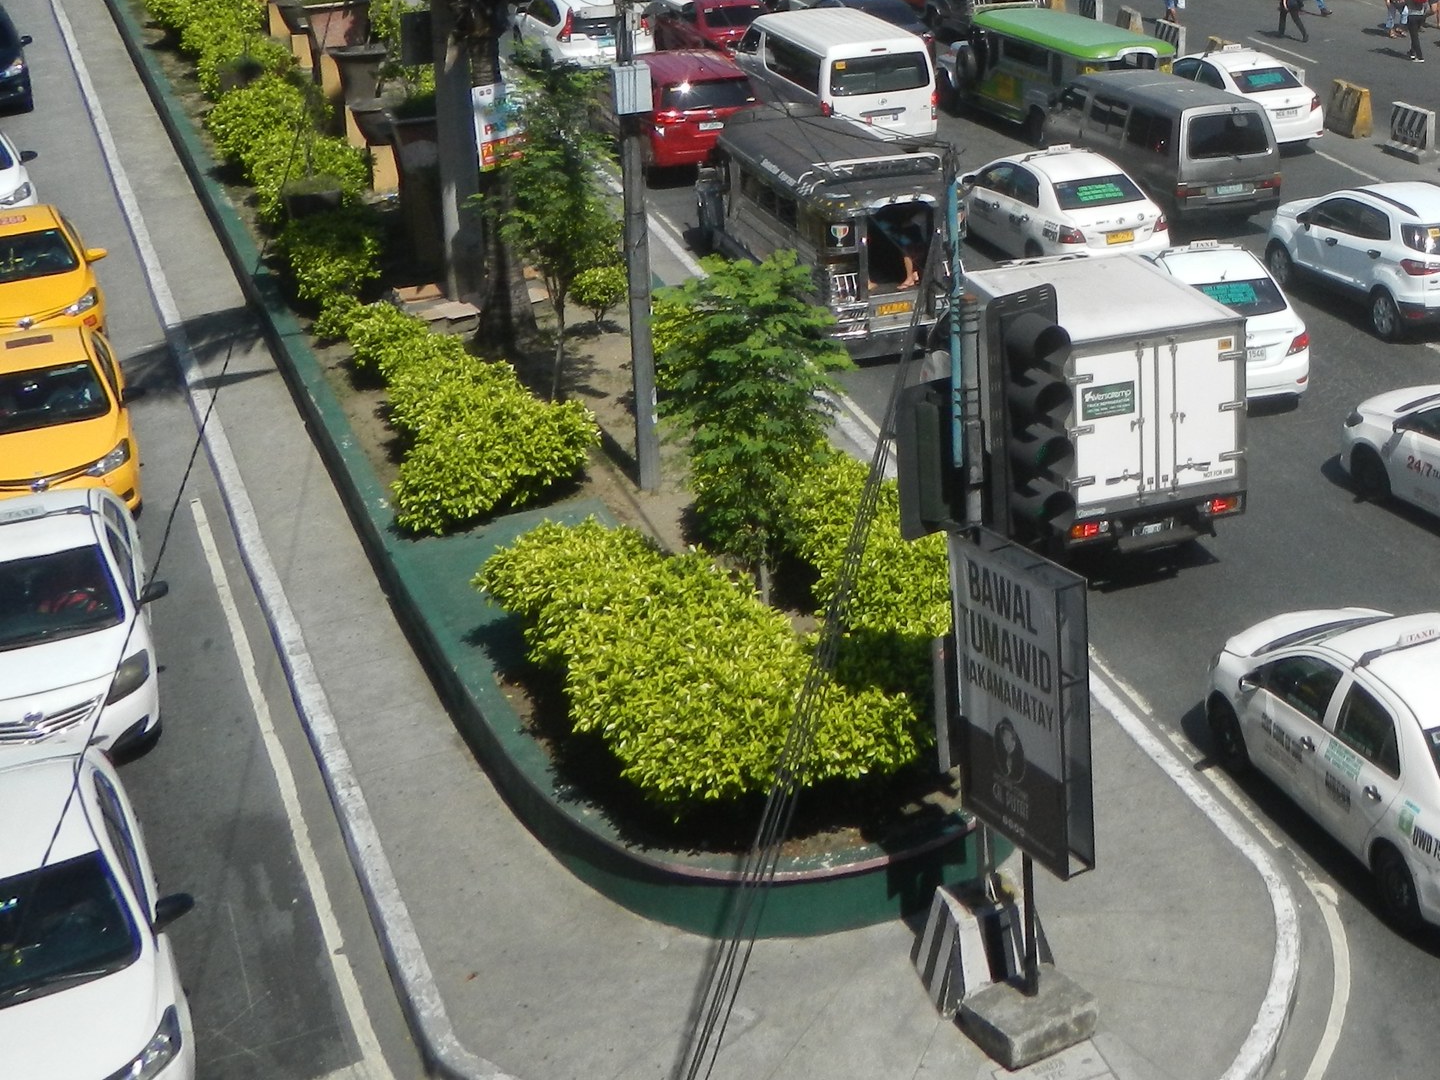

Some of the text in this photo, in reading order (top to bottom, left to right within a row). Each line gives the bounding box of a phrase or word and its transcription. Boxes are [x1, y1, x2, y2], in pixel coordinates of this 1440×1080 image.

[1406, 455, 1432, 478] 24/7
[967, 559, 1037, 636] BAWAL
[959, 602, 1051, 694] TUMAWID
[1406, 629, 1435, 642] TAXI
